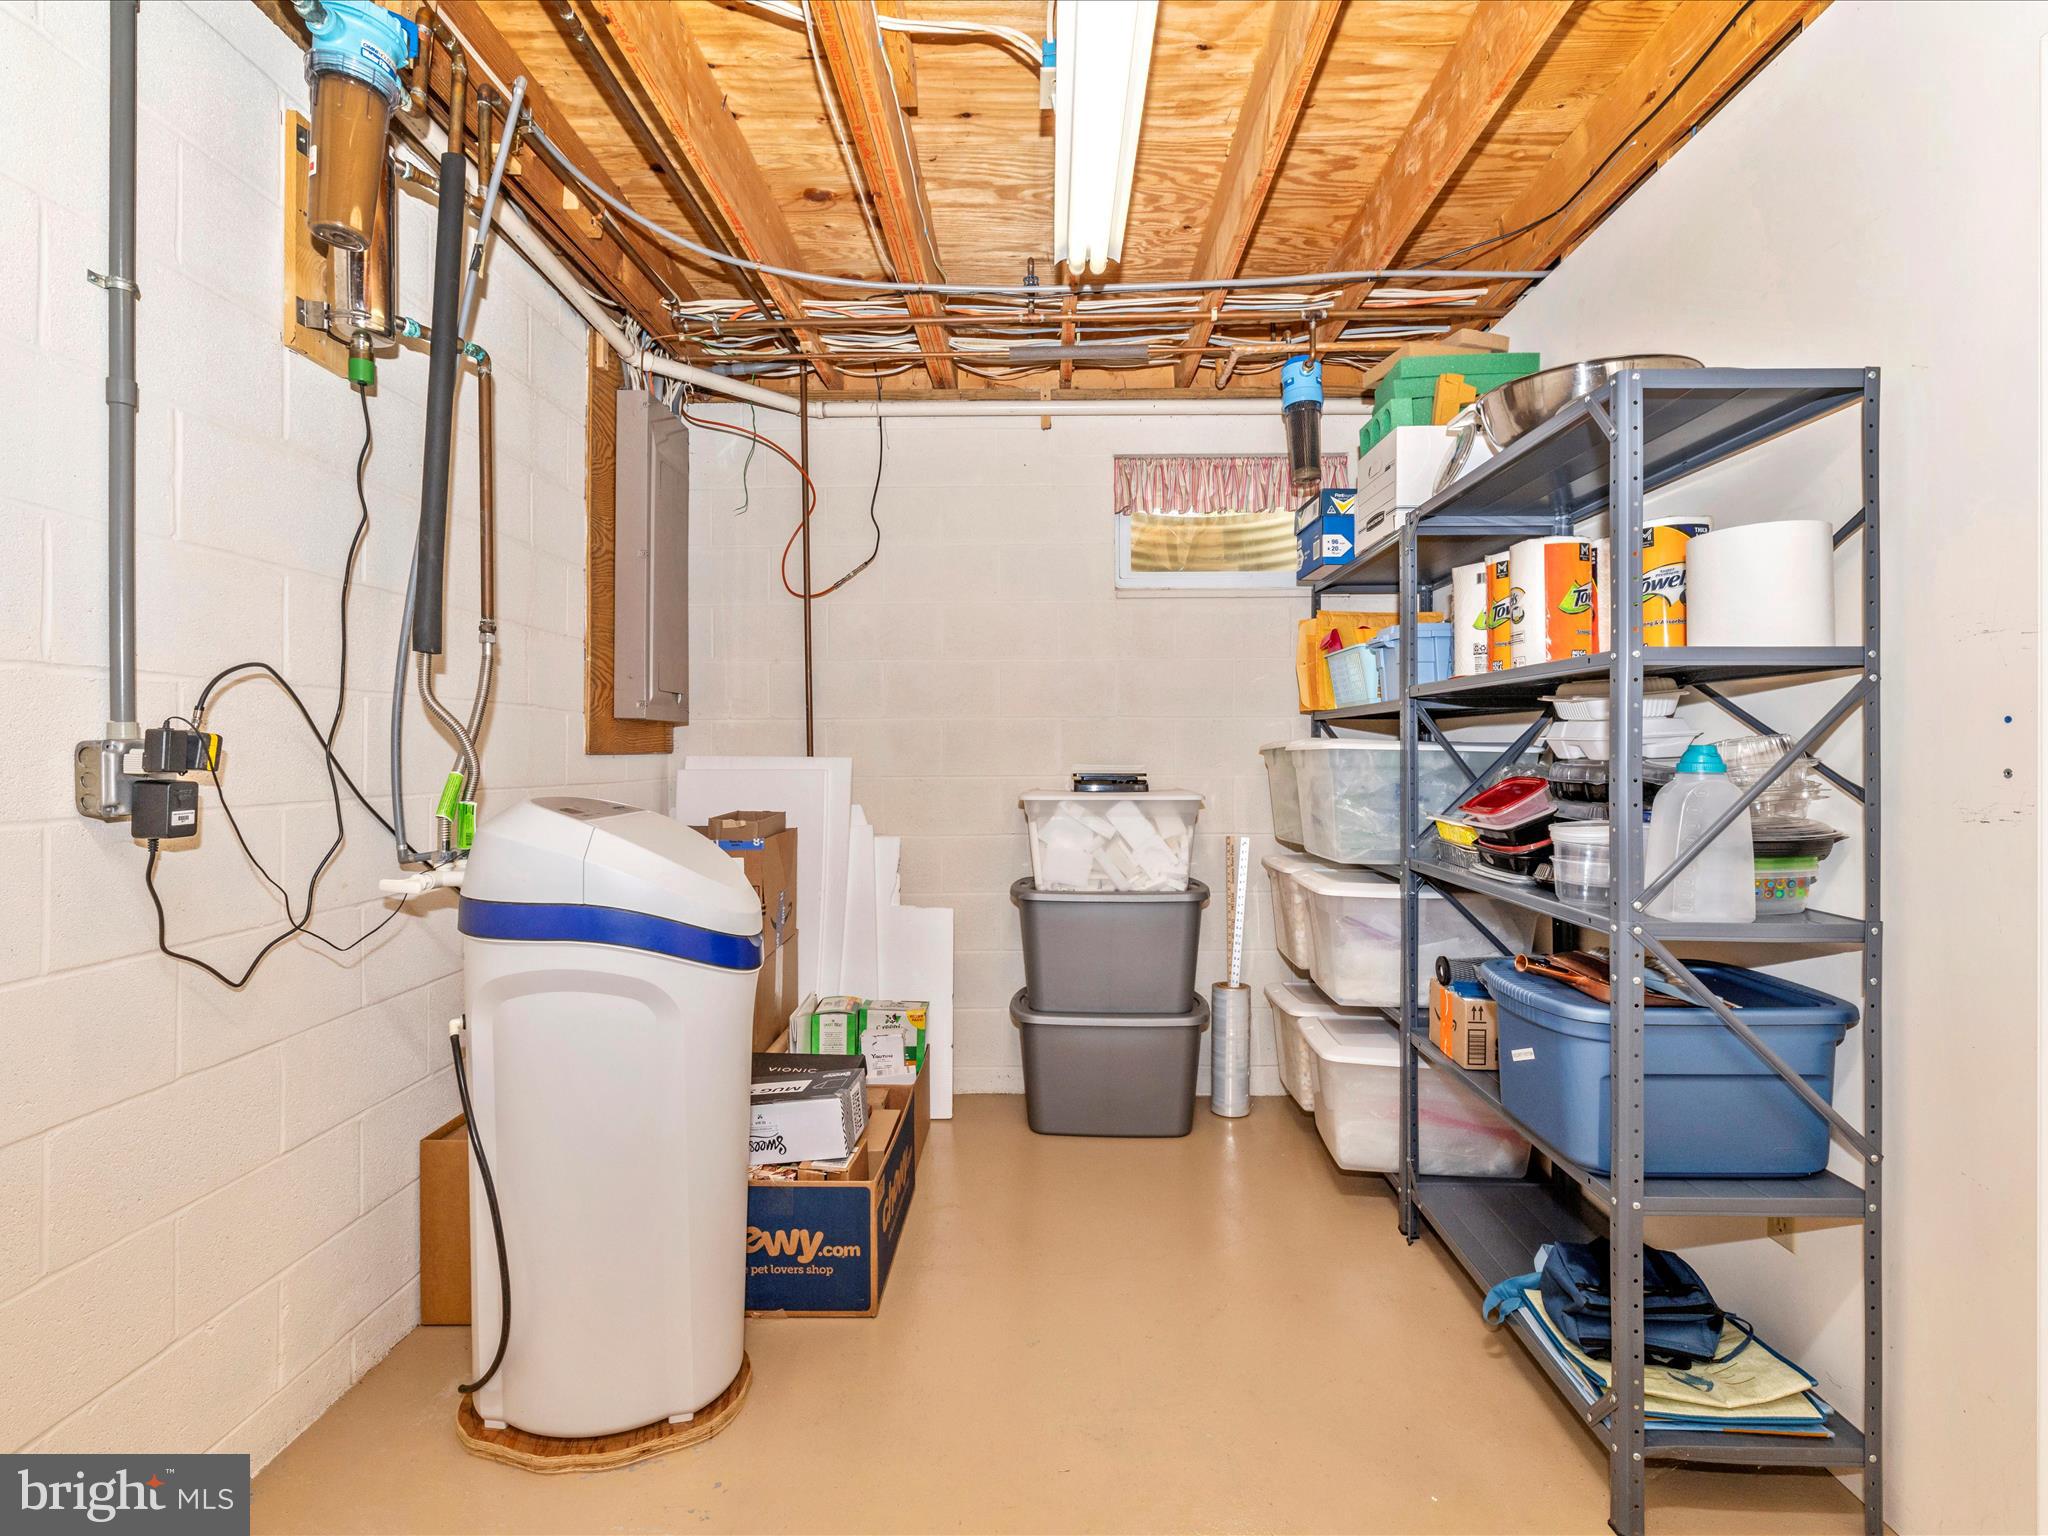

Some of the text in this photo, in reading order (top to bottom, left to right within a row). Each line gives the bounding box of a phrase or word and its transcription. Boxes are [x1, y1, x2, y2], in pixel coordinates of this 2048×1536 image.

[1642, 569, 1686, 594] owel
[768, 1066, 818, 1074] VIONIC
[751, 1264, 834, 1276] pet lovers shop
